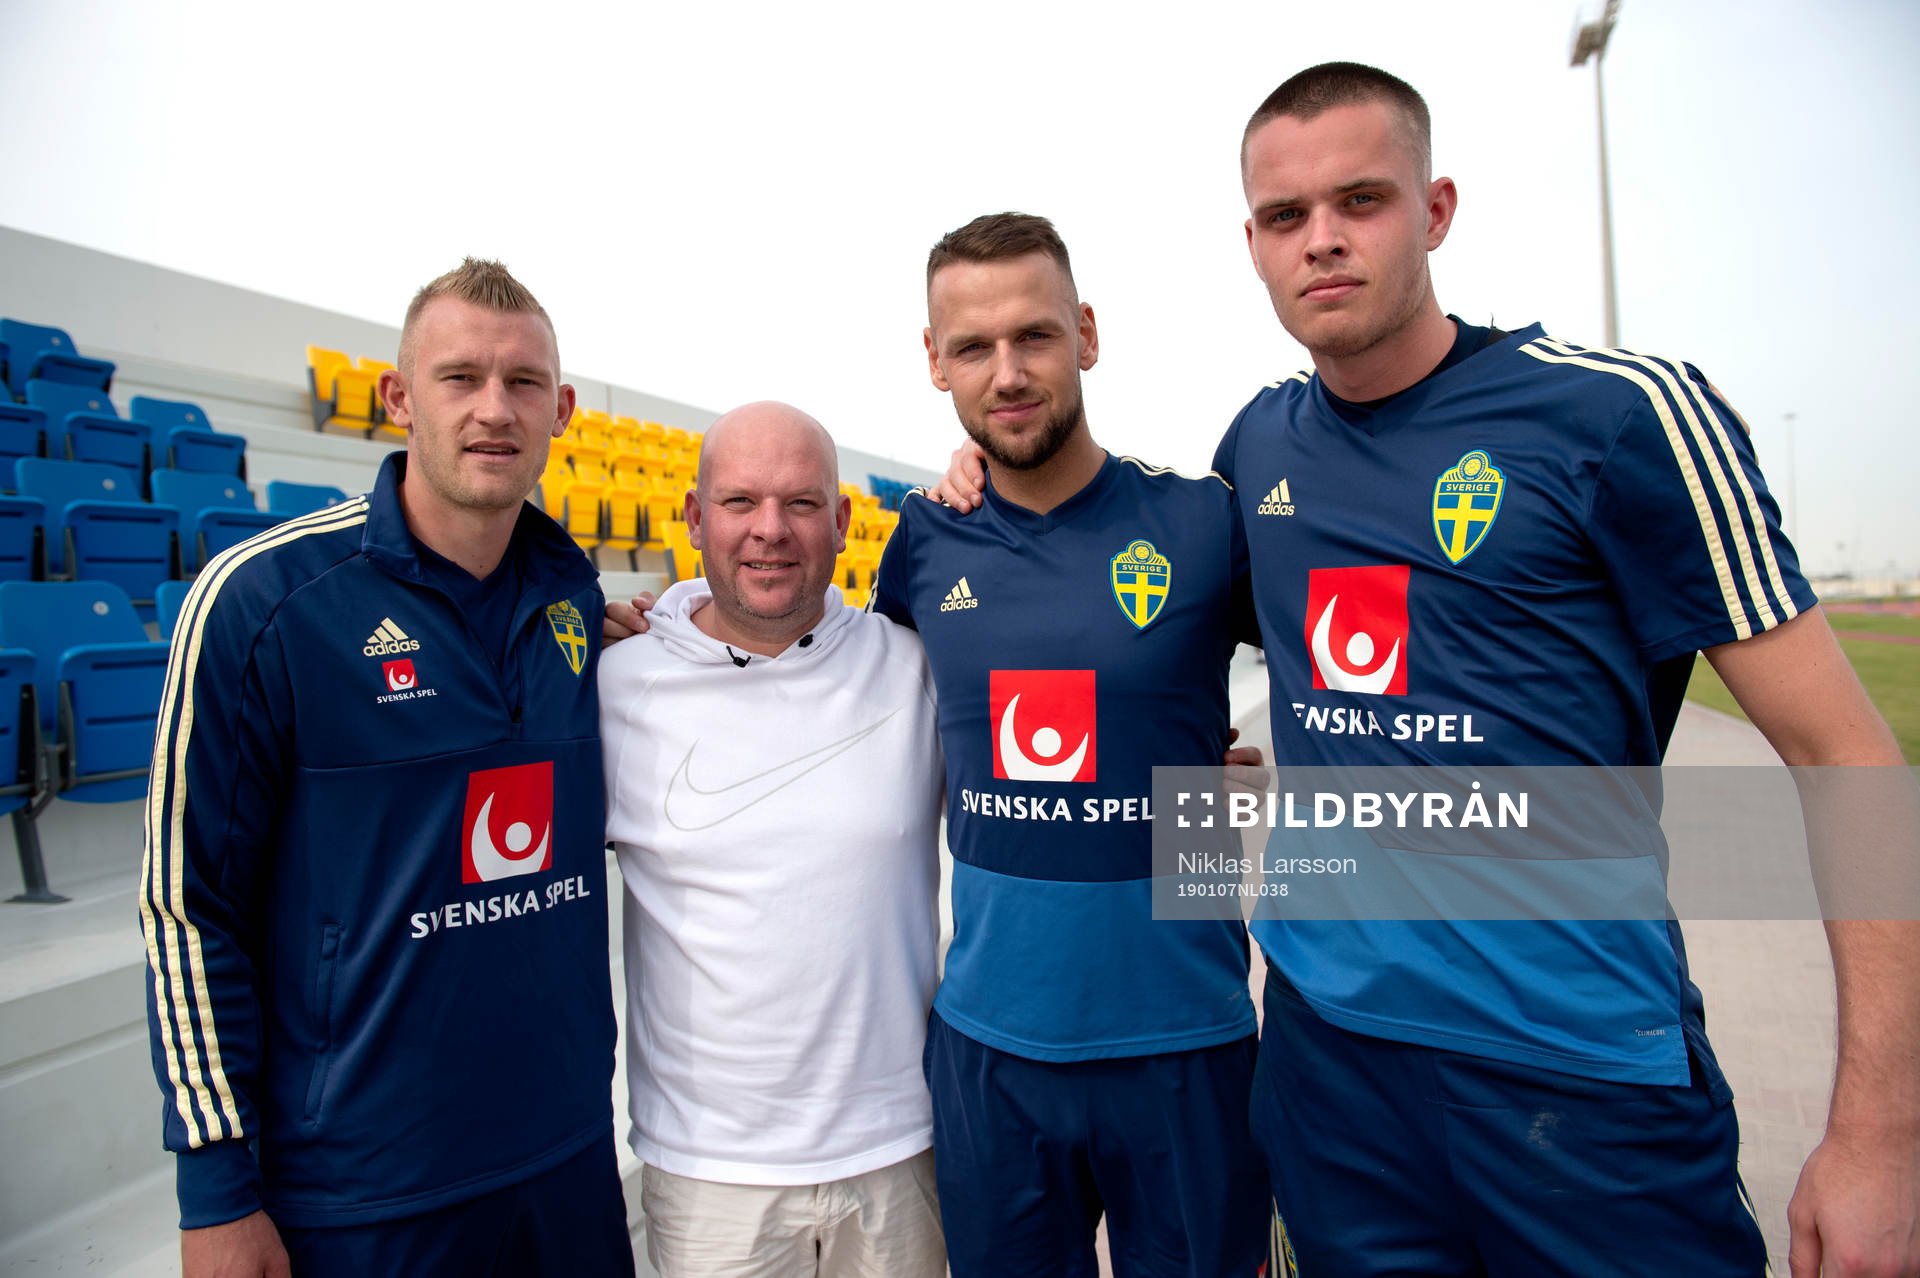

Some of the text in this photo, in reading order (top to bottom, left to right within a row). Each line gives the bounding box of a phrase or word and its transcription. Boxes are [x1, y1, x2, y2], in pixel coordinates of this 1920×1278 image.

[1446, 483, 1491, 492] SVERIGE
[1257, 500, 1296, 516] adidas
[1122, 564, 1162, 573] SVERIGE
[940, 598, 978, 612] adidas
[363, 638, 420, 656] adidas
[376, 688, 438, 704] SVENSKA SPEL
[1391, 714, 1484, 742] SPEL
[961, 788, 1156, 823] SVENSKA SPEL
[410, 875, 590, 939] SVENSKA SPEL
